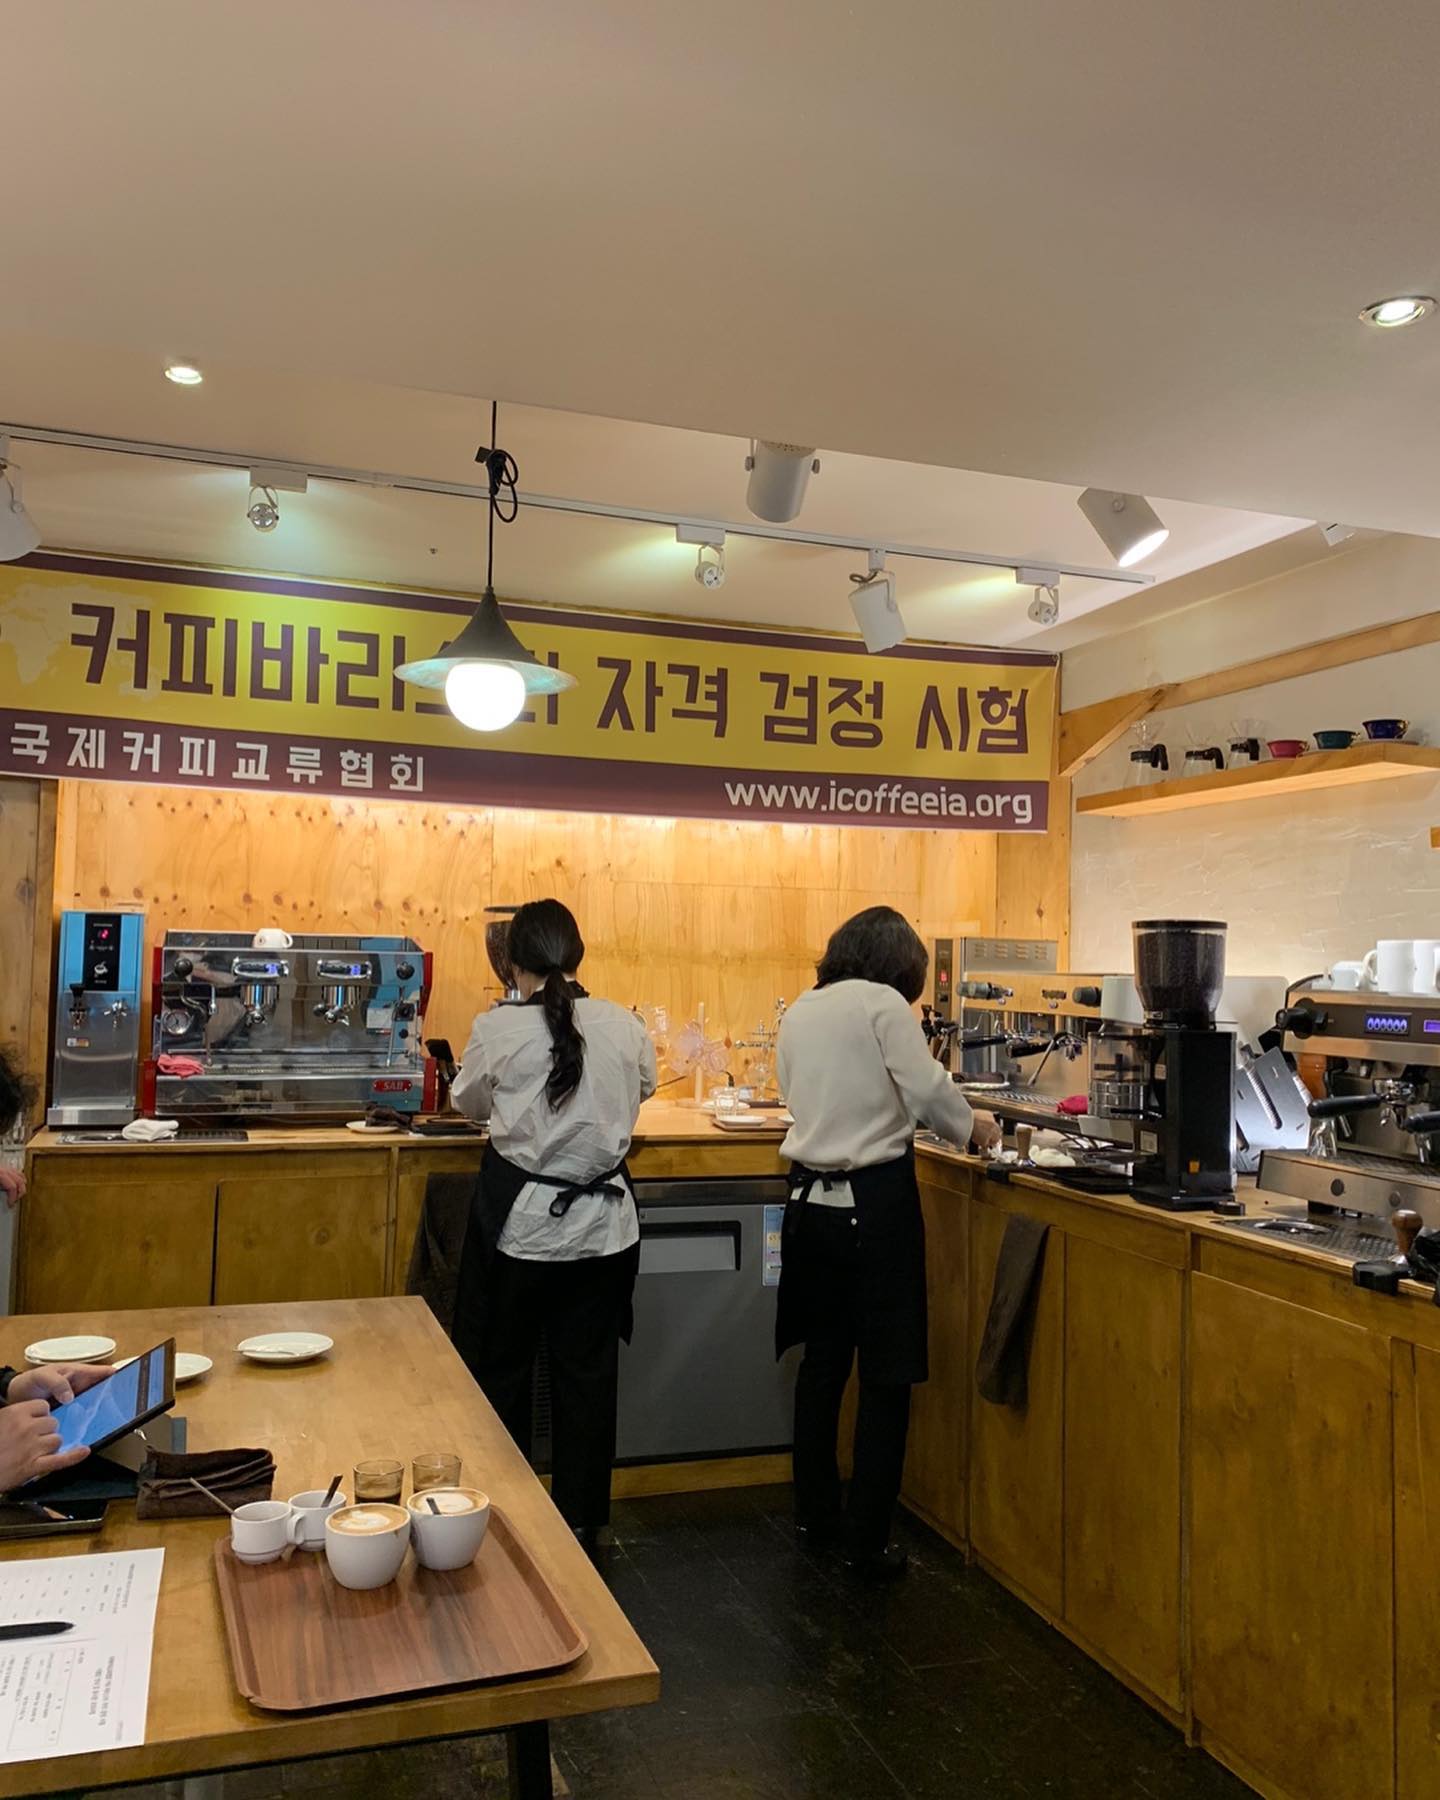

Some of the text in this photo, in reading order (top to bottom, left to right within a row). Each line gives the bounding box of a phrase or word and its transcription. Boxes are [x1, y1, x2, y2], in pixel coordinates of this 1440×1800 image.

[71, 602, 1030, 754] 커피바리 자격 검정 시험
[725, 780, 1032, 824] www.icoffeeia.org
